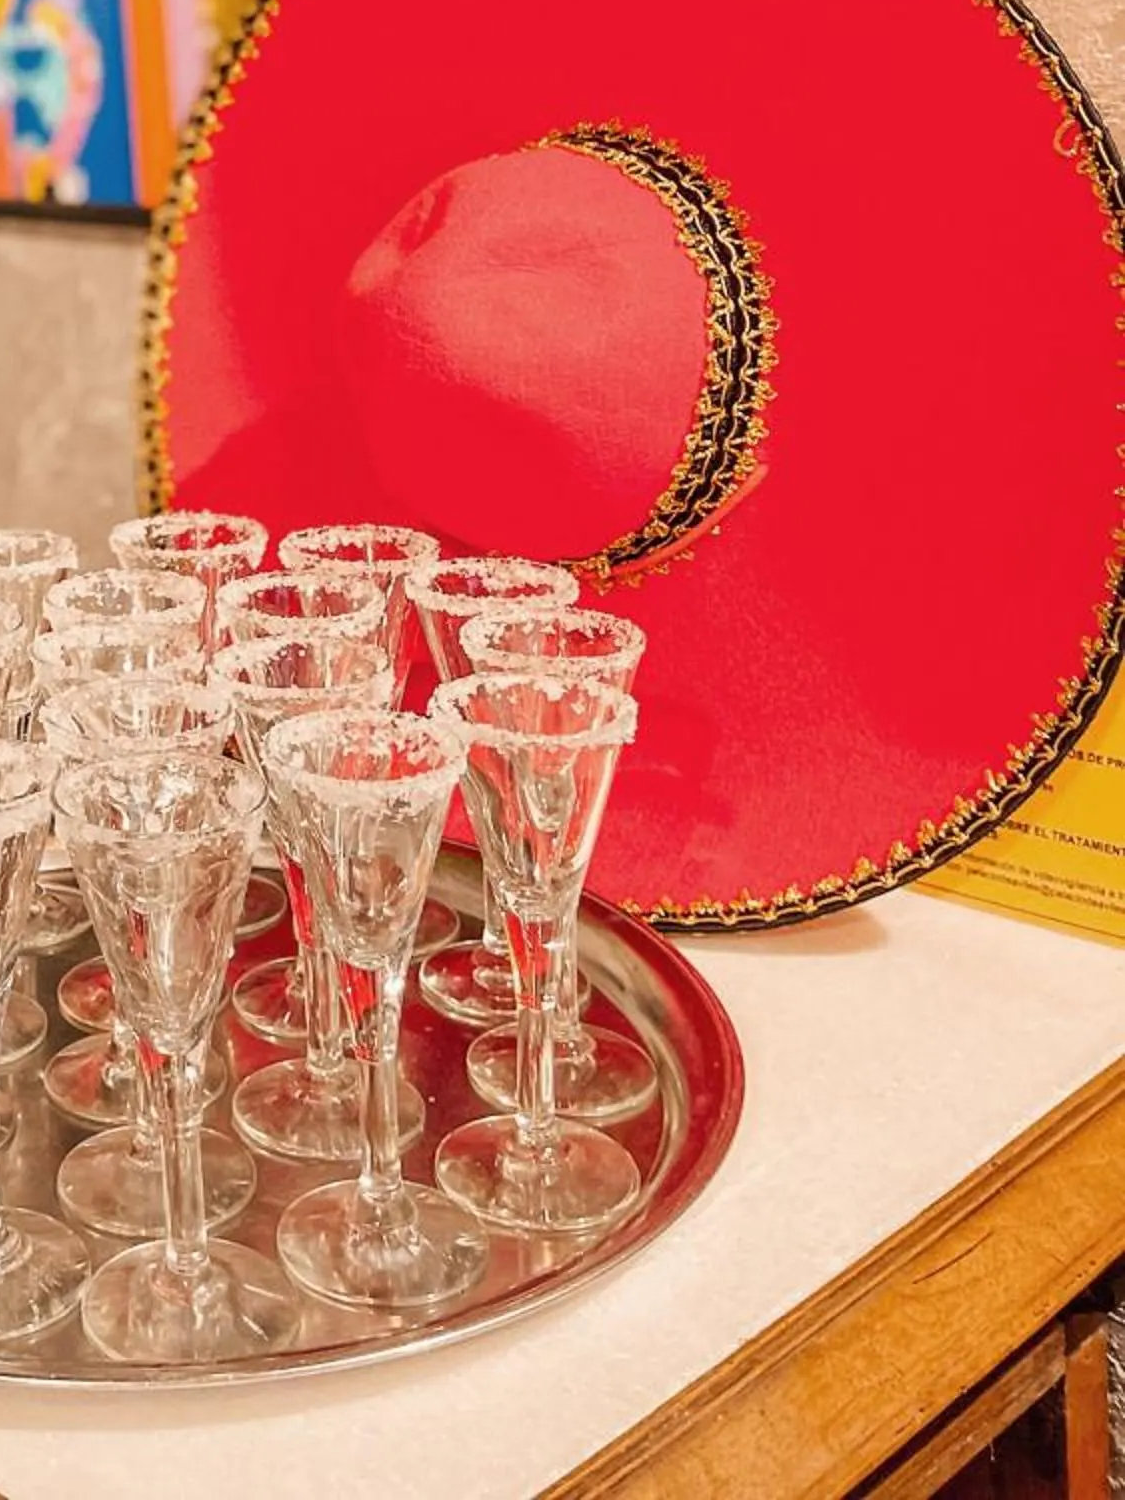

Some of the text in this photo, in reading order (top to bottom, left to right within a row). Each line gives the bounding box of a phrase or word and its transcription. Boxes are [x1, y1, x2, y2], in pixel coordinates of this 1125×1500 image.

[1086, 752, 1103, 764] DE
[1034, 825, 1050, 839] EL
[1051, 829, 1125, 857] TRATAMIENT
